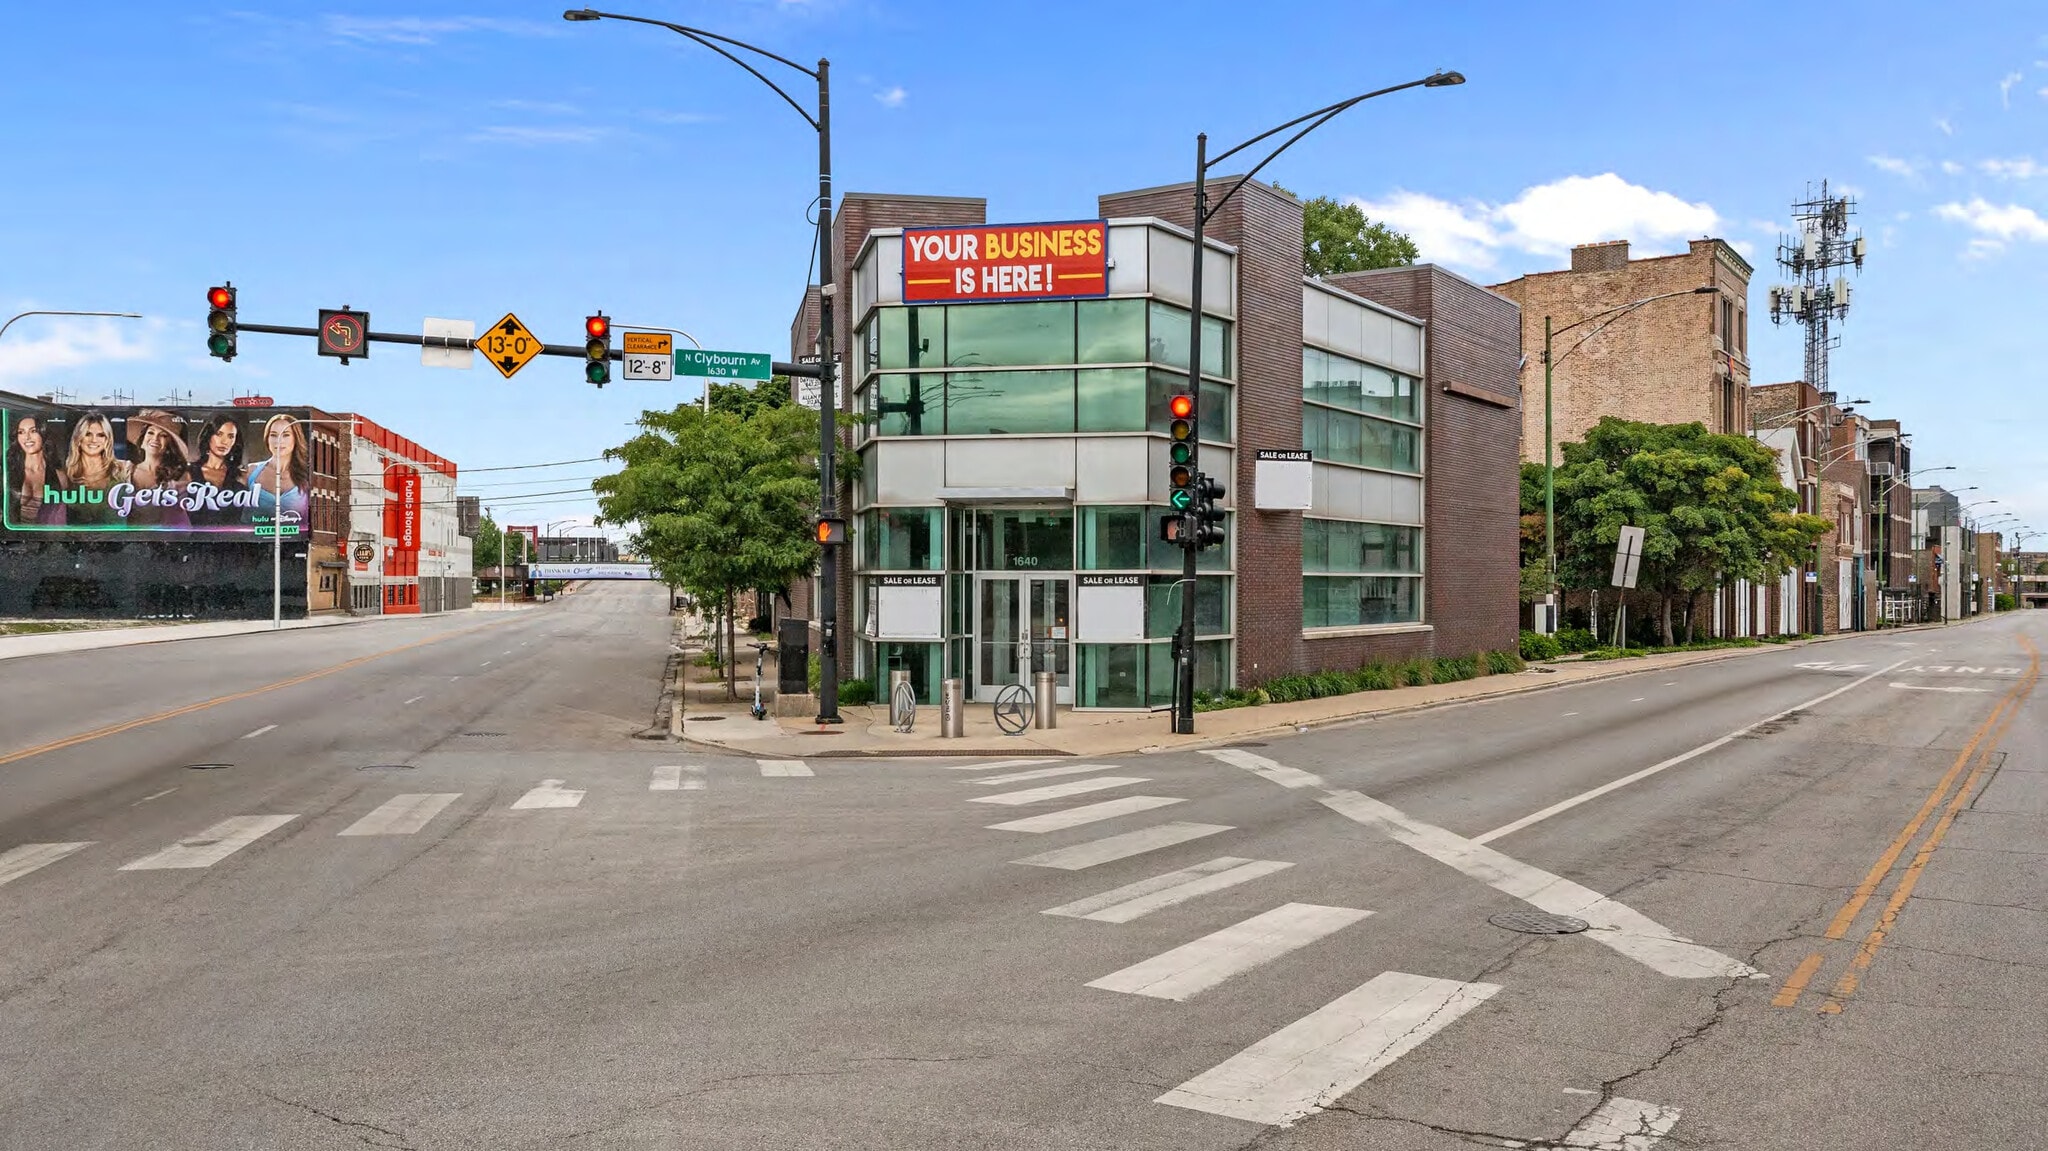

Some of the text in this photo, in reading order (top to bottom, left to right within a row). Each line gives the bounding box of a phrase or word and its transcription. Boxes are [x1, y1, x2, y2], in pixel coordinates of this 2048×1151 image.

[909, 228, 1102, 262] YOUR BUSINESS
[955, 263, 1053, 294] IS HERE!
[685, 352, 761, 366] N Clybourn Av
[707, 367, 739, 376] 1630 W
[1260, 451, 1278, 459] SALE
[1287, 452, 1309, 460] LEASE
[44, 481, 260, 517] hulu Gets Real
[403, 480, 414, 547] Public Storage
[251, 515, 269, 523] hulu
[1013, 556, 1038, 566] 1640
[883, 576, 902, 585] SALE
[913, 577, 937, 585] LEASE
[1083, 576, 1102, 584] SALE
[1114, 576, 1139, 584] LEASE
